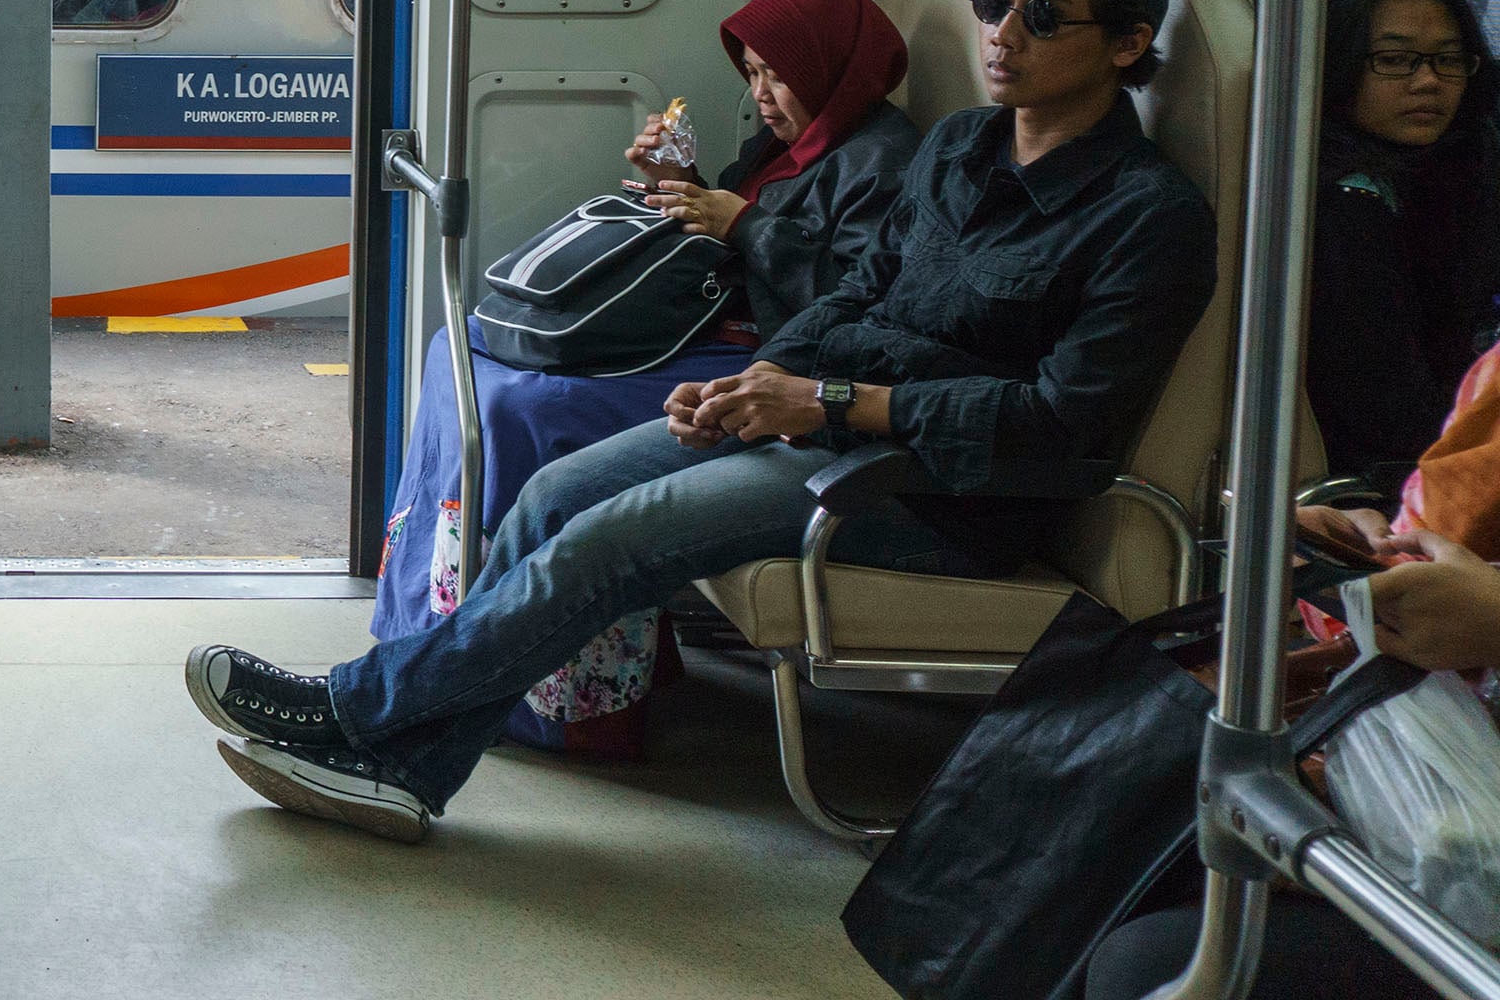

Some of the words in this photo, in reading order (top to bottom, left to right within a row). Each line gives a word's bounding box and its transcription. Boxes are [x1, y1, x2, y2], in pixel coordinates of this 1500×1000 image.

[235, 72, 350, 99] LOGAWA
[184, 111, 319, 123] PURWOKERTO-JEMBER
[321, 111, 340, 123] PP.
